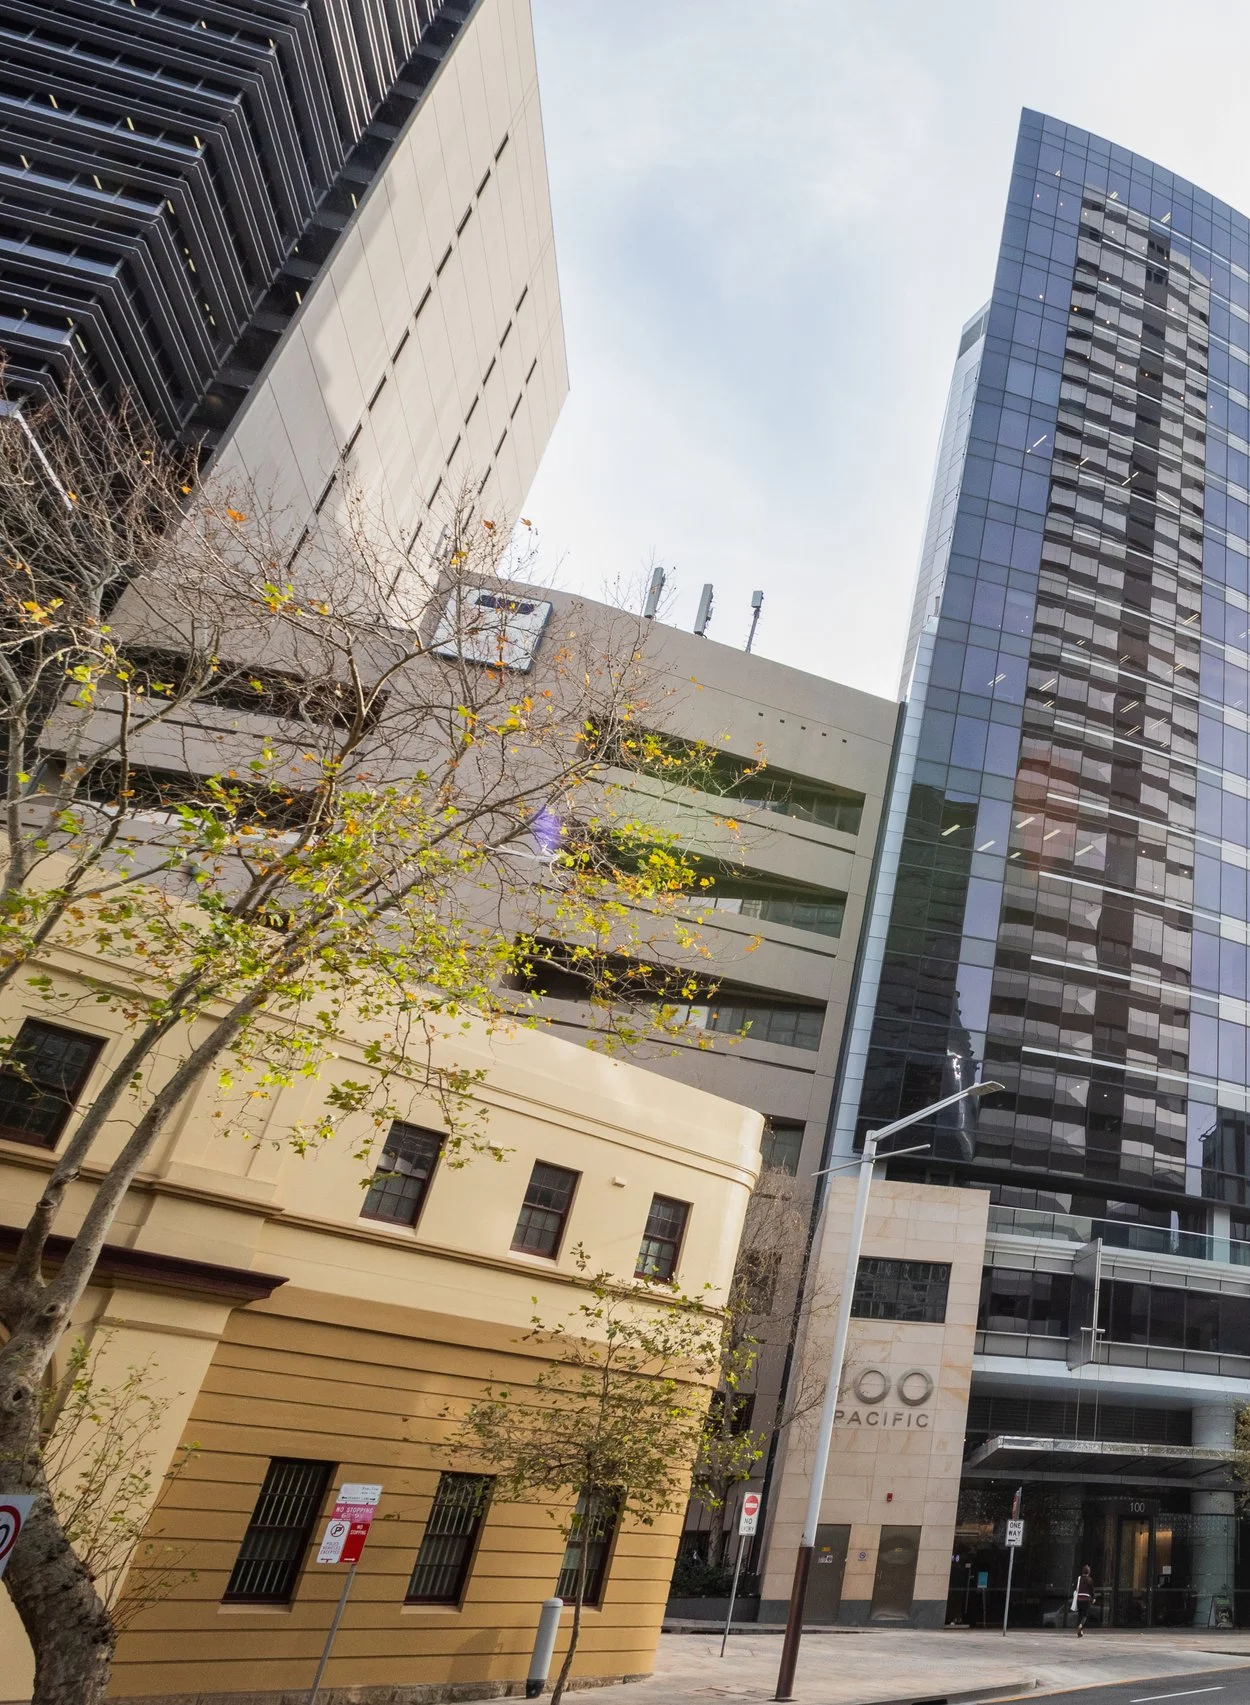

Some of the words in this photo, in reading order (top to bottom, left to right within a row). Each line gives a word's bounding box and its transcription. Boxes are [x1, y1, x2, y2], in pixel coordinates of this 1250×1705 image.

[833, 1409, 929, 1428] PACIFIC
[1129, 1502, 1146, 1513] 100
[1009, 1521, 1021, 1529] ONE
